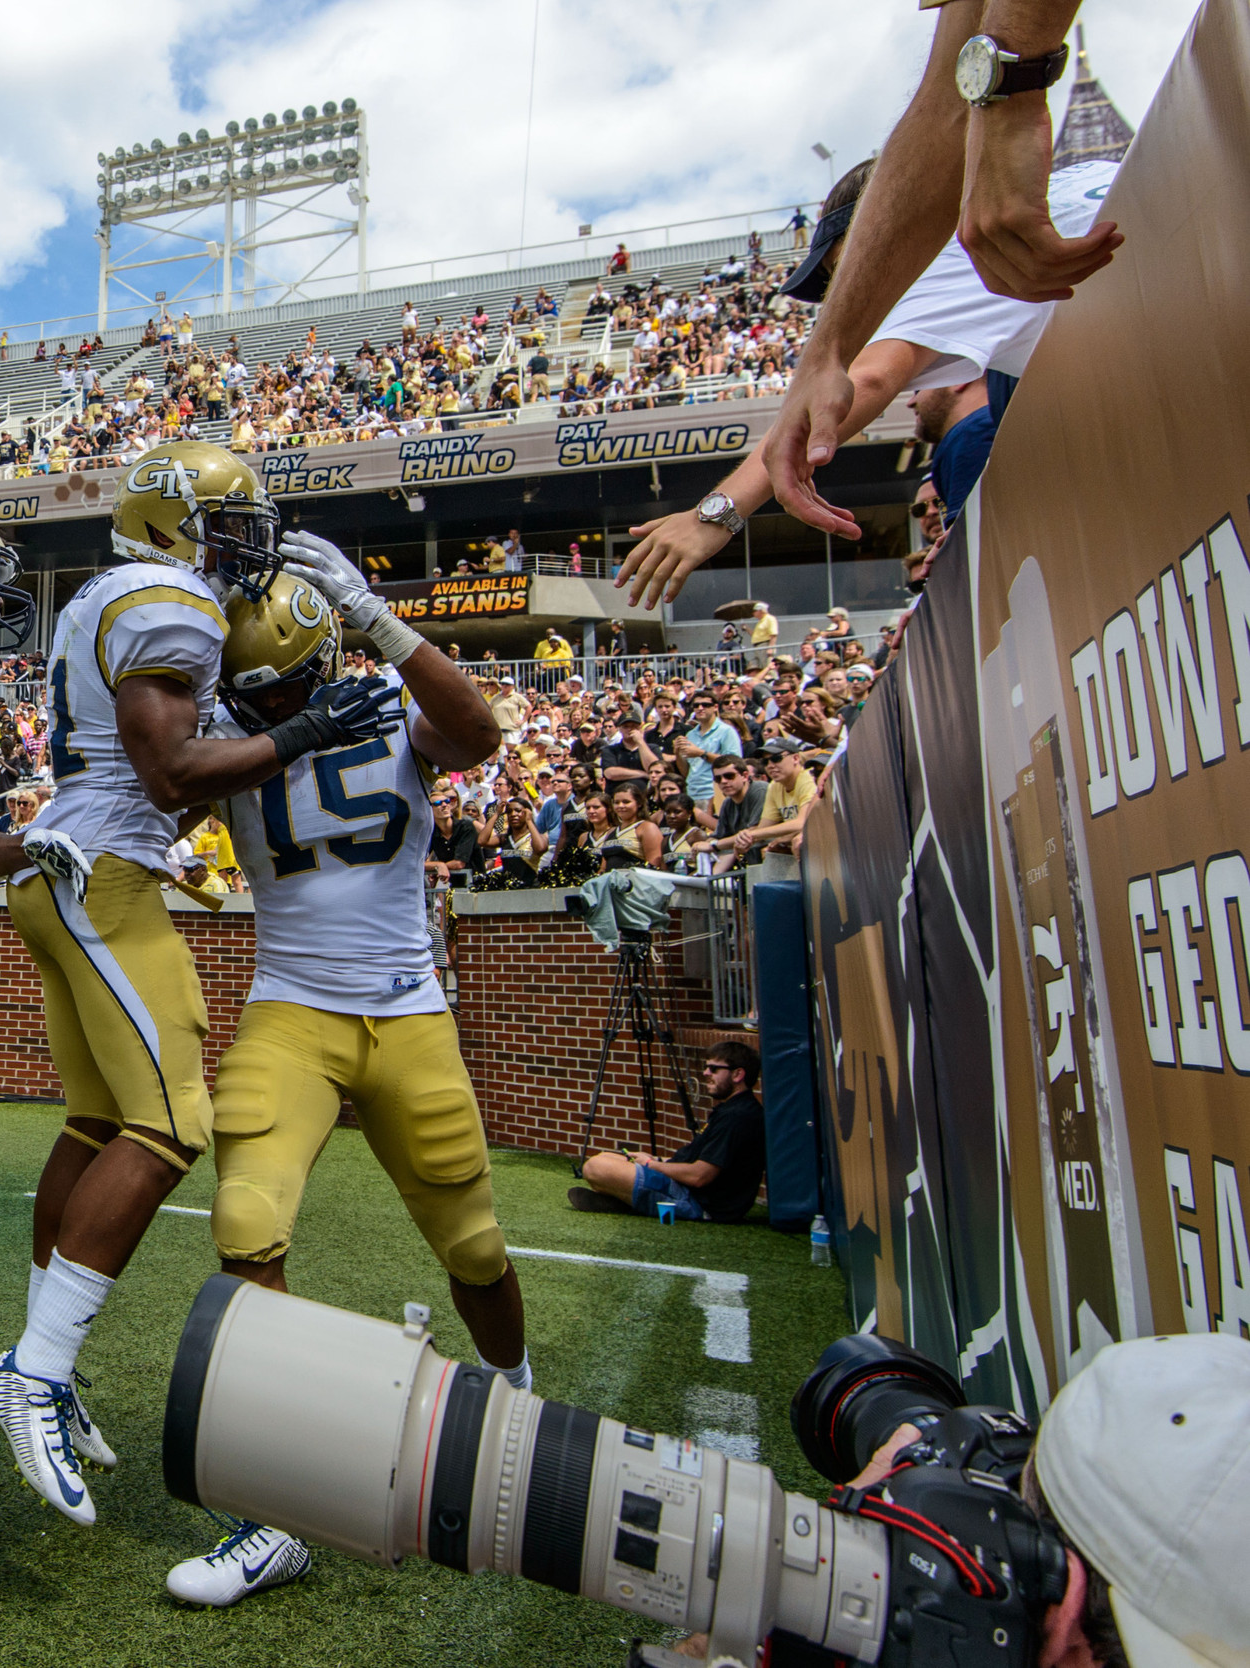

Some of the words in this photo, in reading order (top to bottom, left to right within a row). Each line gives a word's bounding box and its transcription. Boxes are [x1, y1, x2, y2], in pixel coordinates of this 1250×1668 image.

[556, 420, 606, 443] PAT
[399, 434, 484, 459] RANDY
[559, 424, 748, 467] SWILLING
[262, 453, 308, 474] RAY
[401, 449, 516, 482] RHINO
[266, 463, 358, 495] BECK
[431, 576, 508, 596] AVAILABLE
[511, 574, 527, 589] IN
[433, 590, 527, 616] STANDS
[243, 672, 262, 685] ACC
[250, 736, 411, 881] 15
